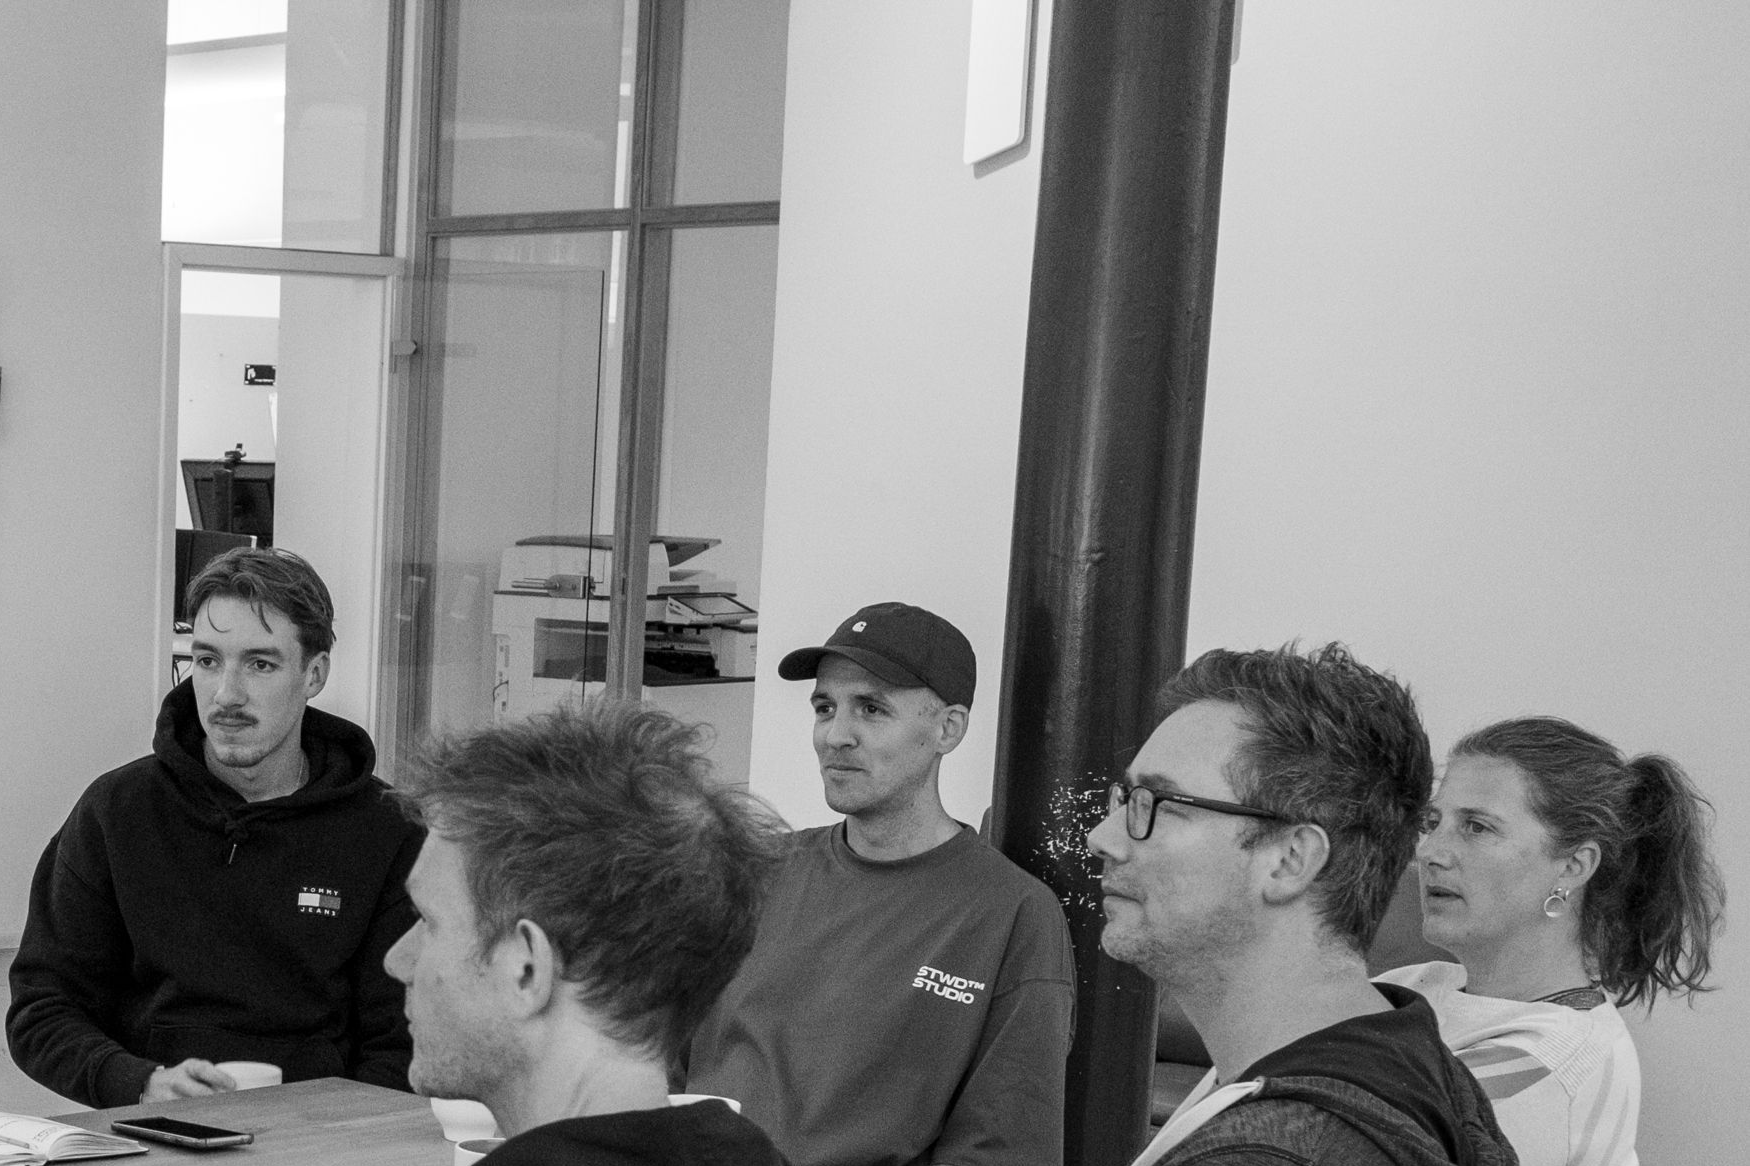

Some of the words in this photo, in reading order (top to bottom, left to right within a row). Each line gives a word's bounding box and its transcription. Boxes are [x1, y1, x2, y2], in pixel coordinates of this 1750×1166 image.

[303, 887, 338, 896] TOMMY
[300, 907, 335, 916] JEANS
[912, 976, 974, 1004] STUDIO
